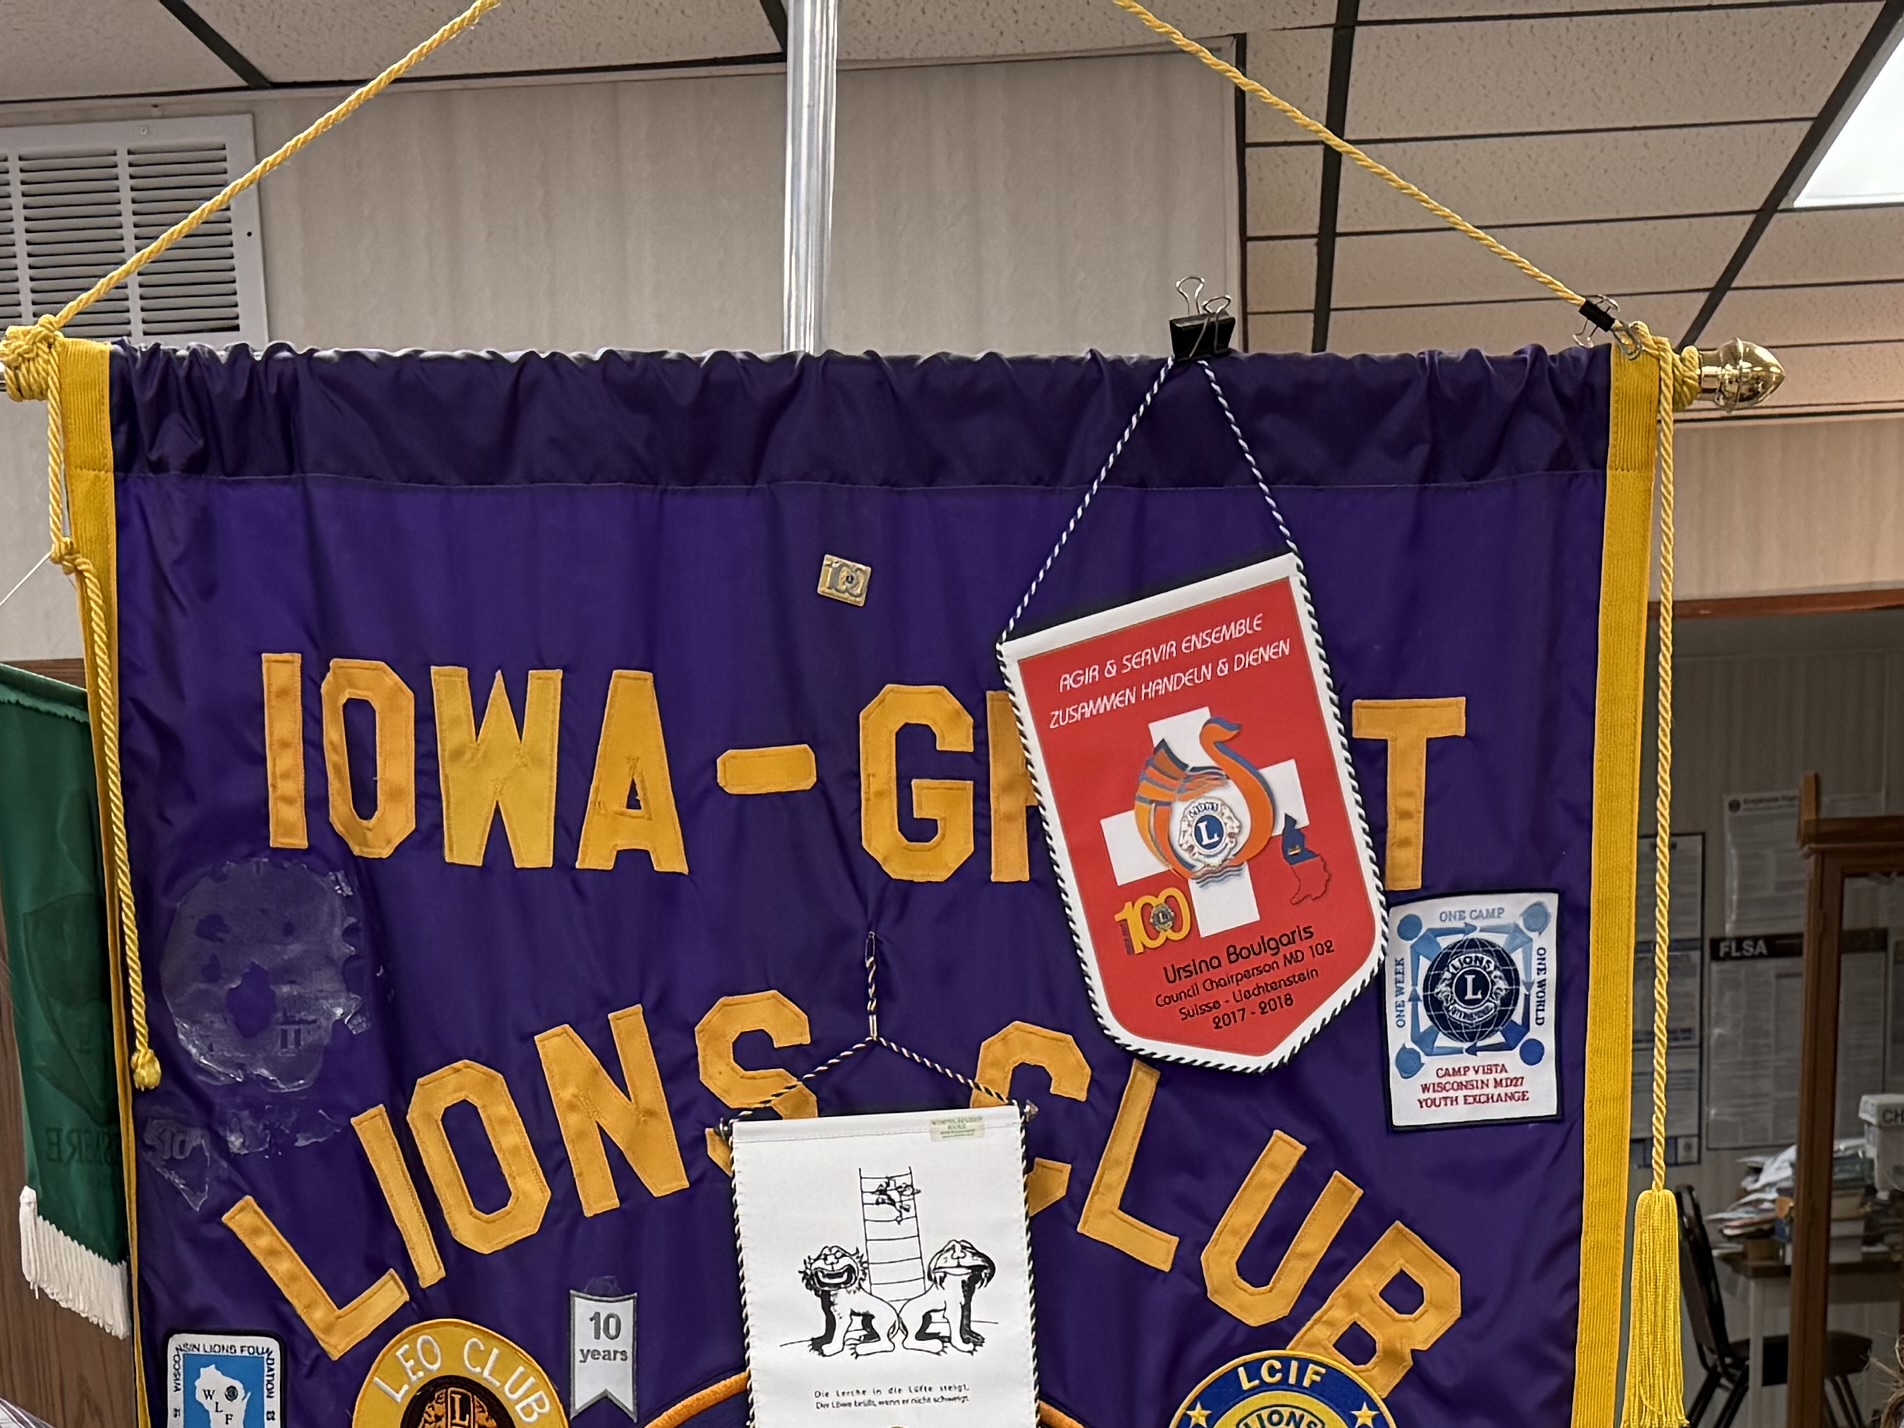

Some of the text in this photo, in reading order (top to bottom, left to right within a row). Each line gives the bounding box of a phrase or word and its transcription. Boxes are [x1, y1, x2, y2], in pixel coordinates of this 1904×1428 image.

[1059, 612, 1263, 692] AGIR SERVIR ENSEMBLE
[1049, 638, 1290, 729] ZUSAMMEN HANDELN DIENEN
[1439, 907, 1505, 922] ONE CAMP
[1226, 925, 1314, 964] Boulgaris
[1719, 939, 1768, 958] FLSA
[1155, 956, 1280, 1008] Council Chairperson
[1179, 1001, 1221, 1022] Suisse
[1213, 993, 1294, 1030] 2017 2018
[1420, 1080, 1490, 1093] WISCONSIN
[1436, 1064, 1508, 1078] CAMP VISTA
[1417, 1090, 1529, 1109] YOUTH EXCHANGE
[222, 990, 1462, 1397] LIONS CLUB
[589, 1311, 622, 1341] 10
[579, 1348, 628, 1363] years
[373, 1334, 551, 1423] LEO CLUB
[1237, 1359, 1327, 1391] LCIF
